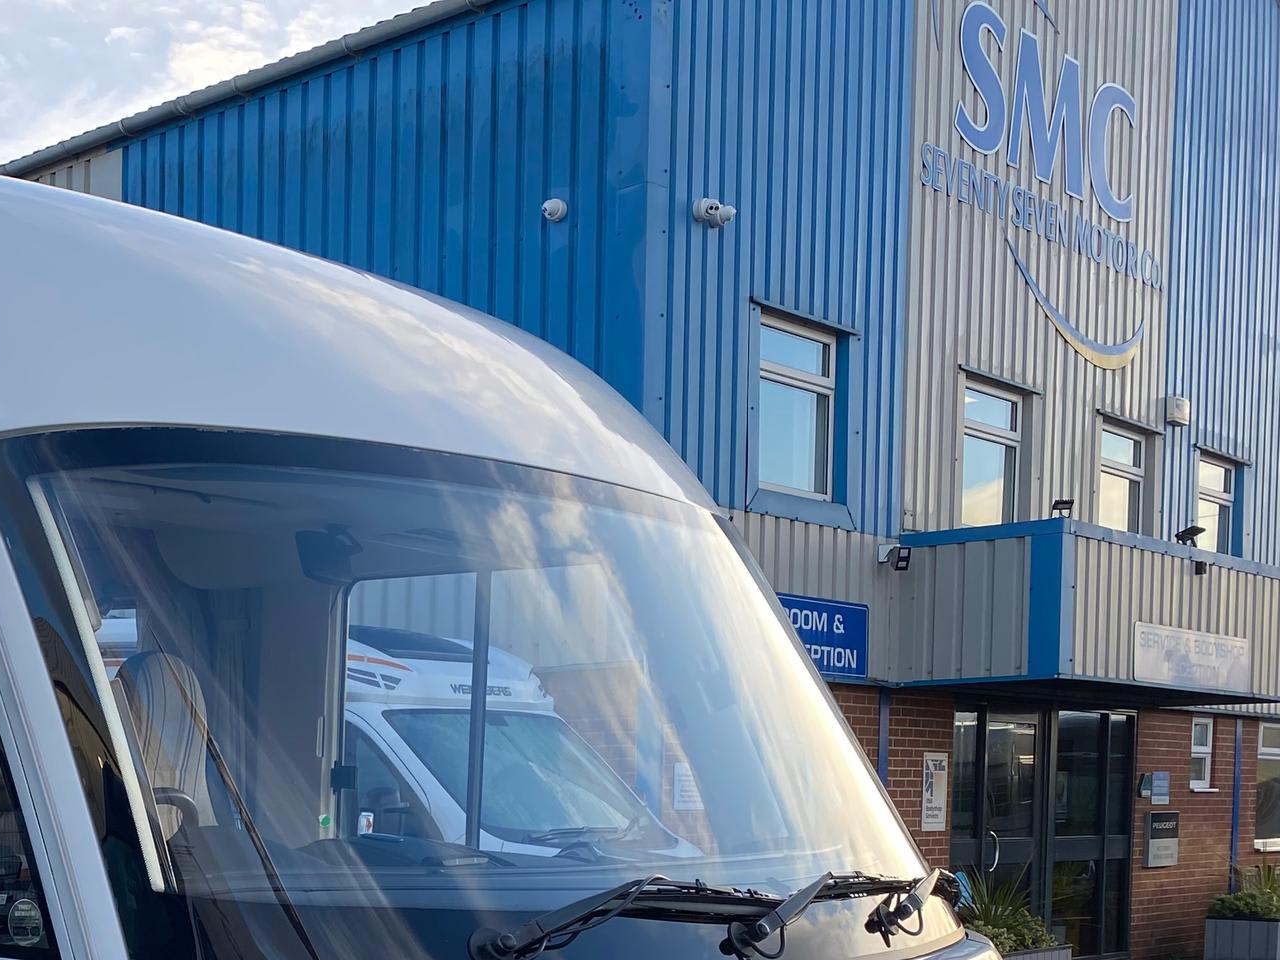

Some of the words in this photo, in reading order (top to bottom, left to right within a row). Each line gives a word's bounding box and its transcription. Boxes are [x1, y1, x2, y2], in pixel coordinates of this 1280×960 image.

[954, 1, 1136, 223] SMC
[920, 141, 1010, 221] SEVENTY
[1012, 185, 1069, 248] SEVEN
[1074, 213, 1138, 280] MOTOR
[833, 614, 845, 634] &
[450, 684, 512, 696] WEBERG
[1152, 821, 1177, 829] PEUGEOT
